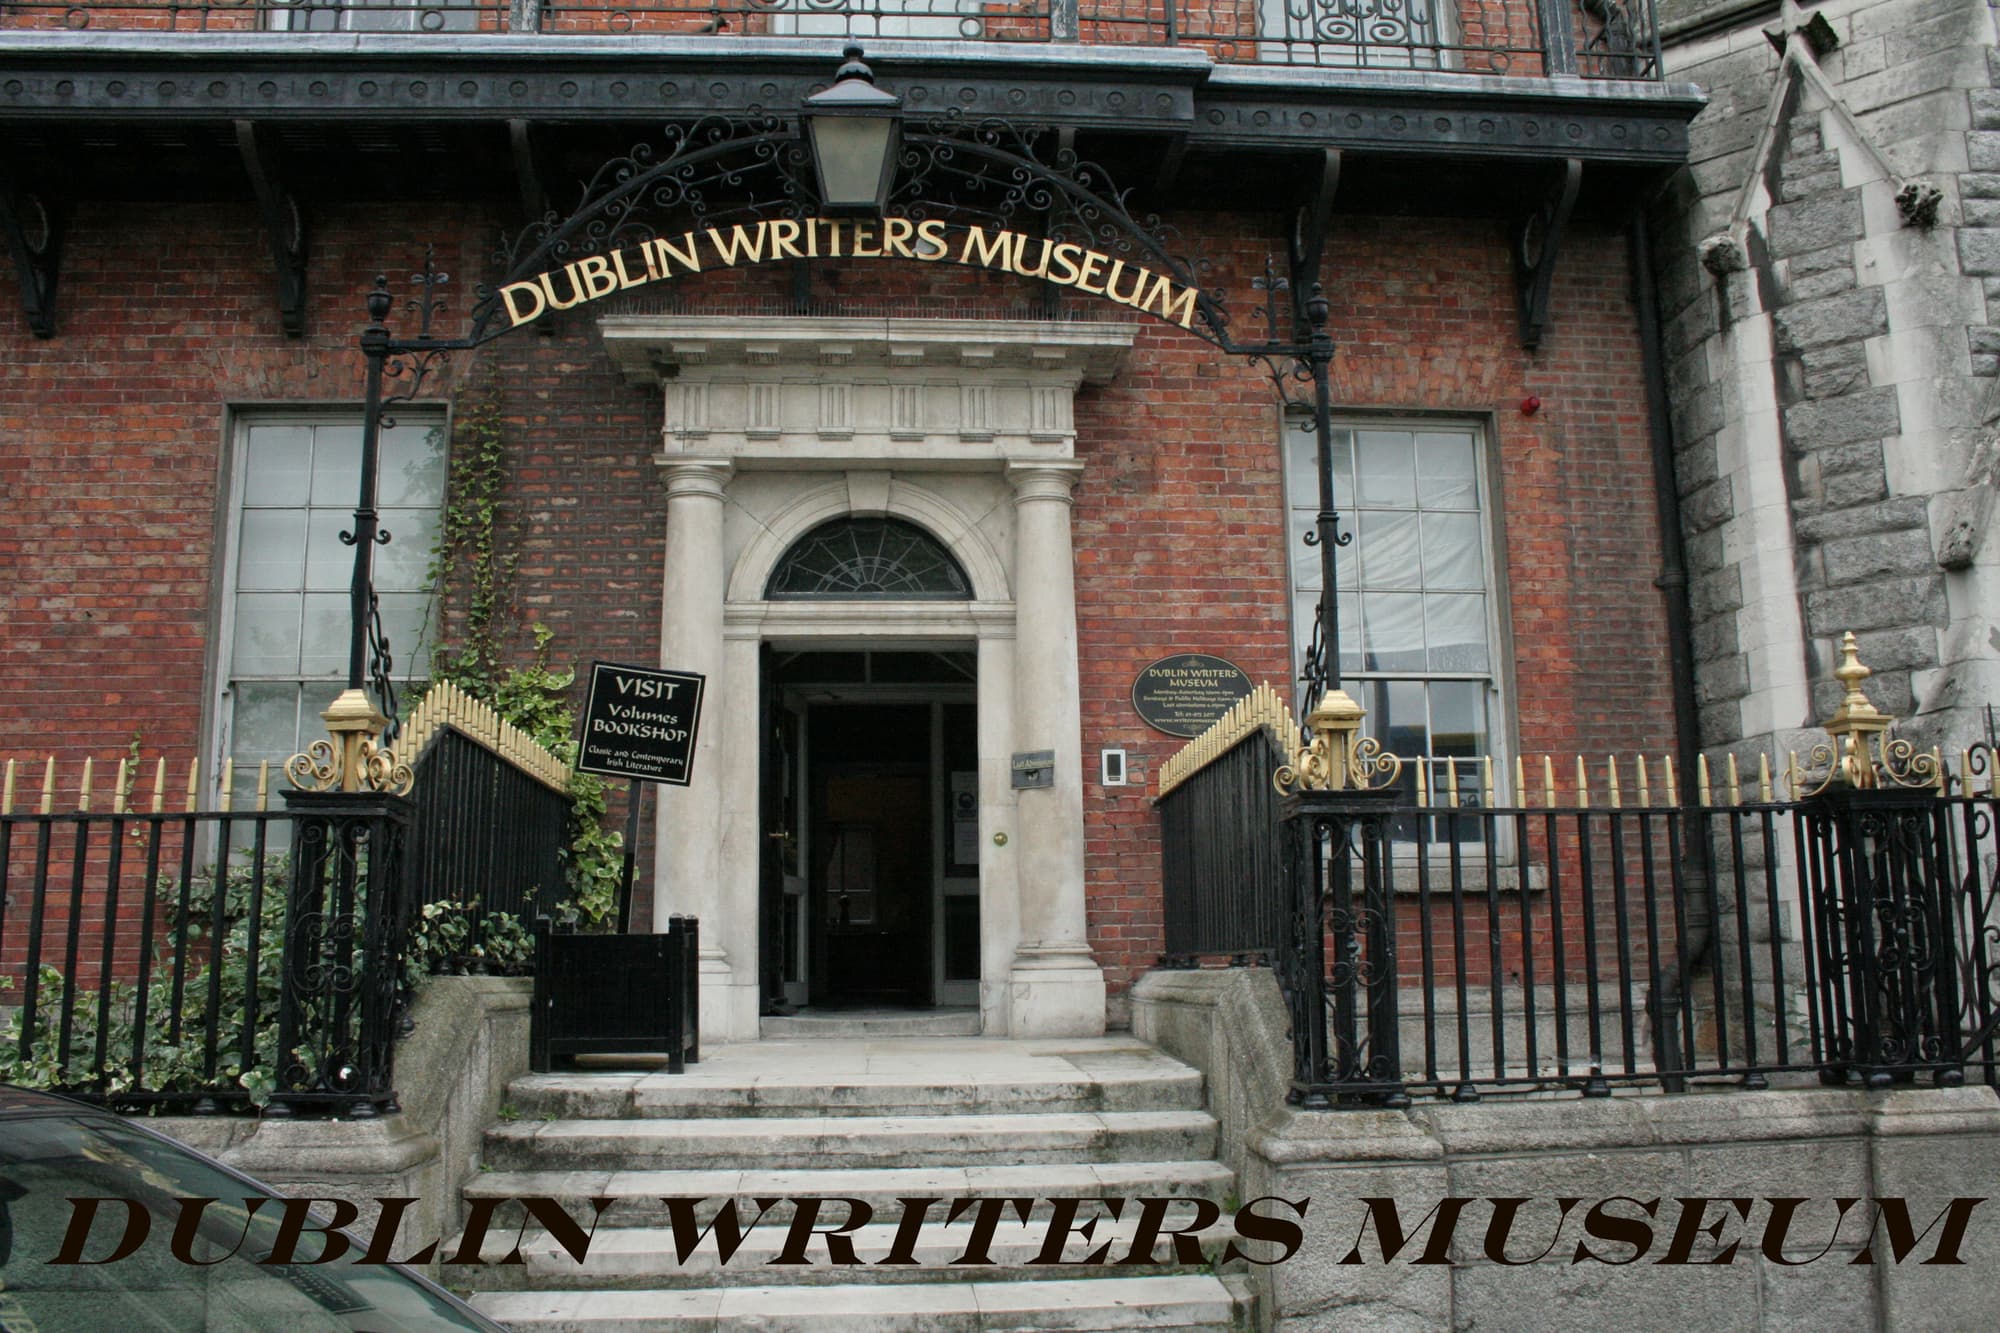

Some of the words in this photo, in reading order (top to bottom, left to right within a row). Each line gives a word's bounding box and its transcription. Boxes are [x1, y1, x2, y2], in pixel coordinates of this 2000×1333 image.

[499, 231, 701, 327] DUBLIN
[706, 216, 948, 267] WRITERS
[959, 225, 1199, 329] MUSEUM
[1149, 669, 1188, 677] DUBLIN
[1190, 669, 1238, 678] WRITERS
[1169, 679, 1218, 687] MUSEUM
[616, 676, 680, 700] VISIT
[608, 703, 678, 724] Volumes
[593, 719, 687, 742] BOOKSHOP
[606, 758, 623, 768] Irish
[625, 761, 663, 773] Literature
[614, 749, 629, 758] and
[631, 751, 683, 766] Contemporary
